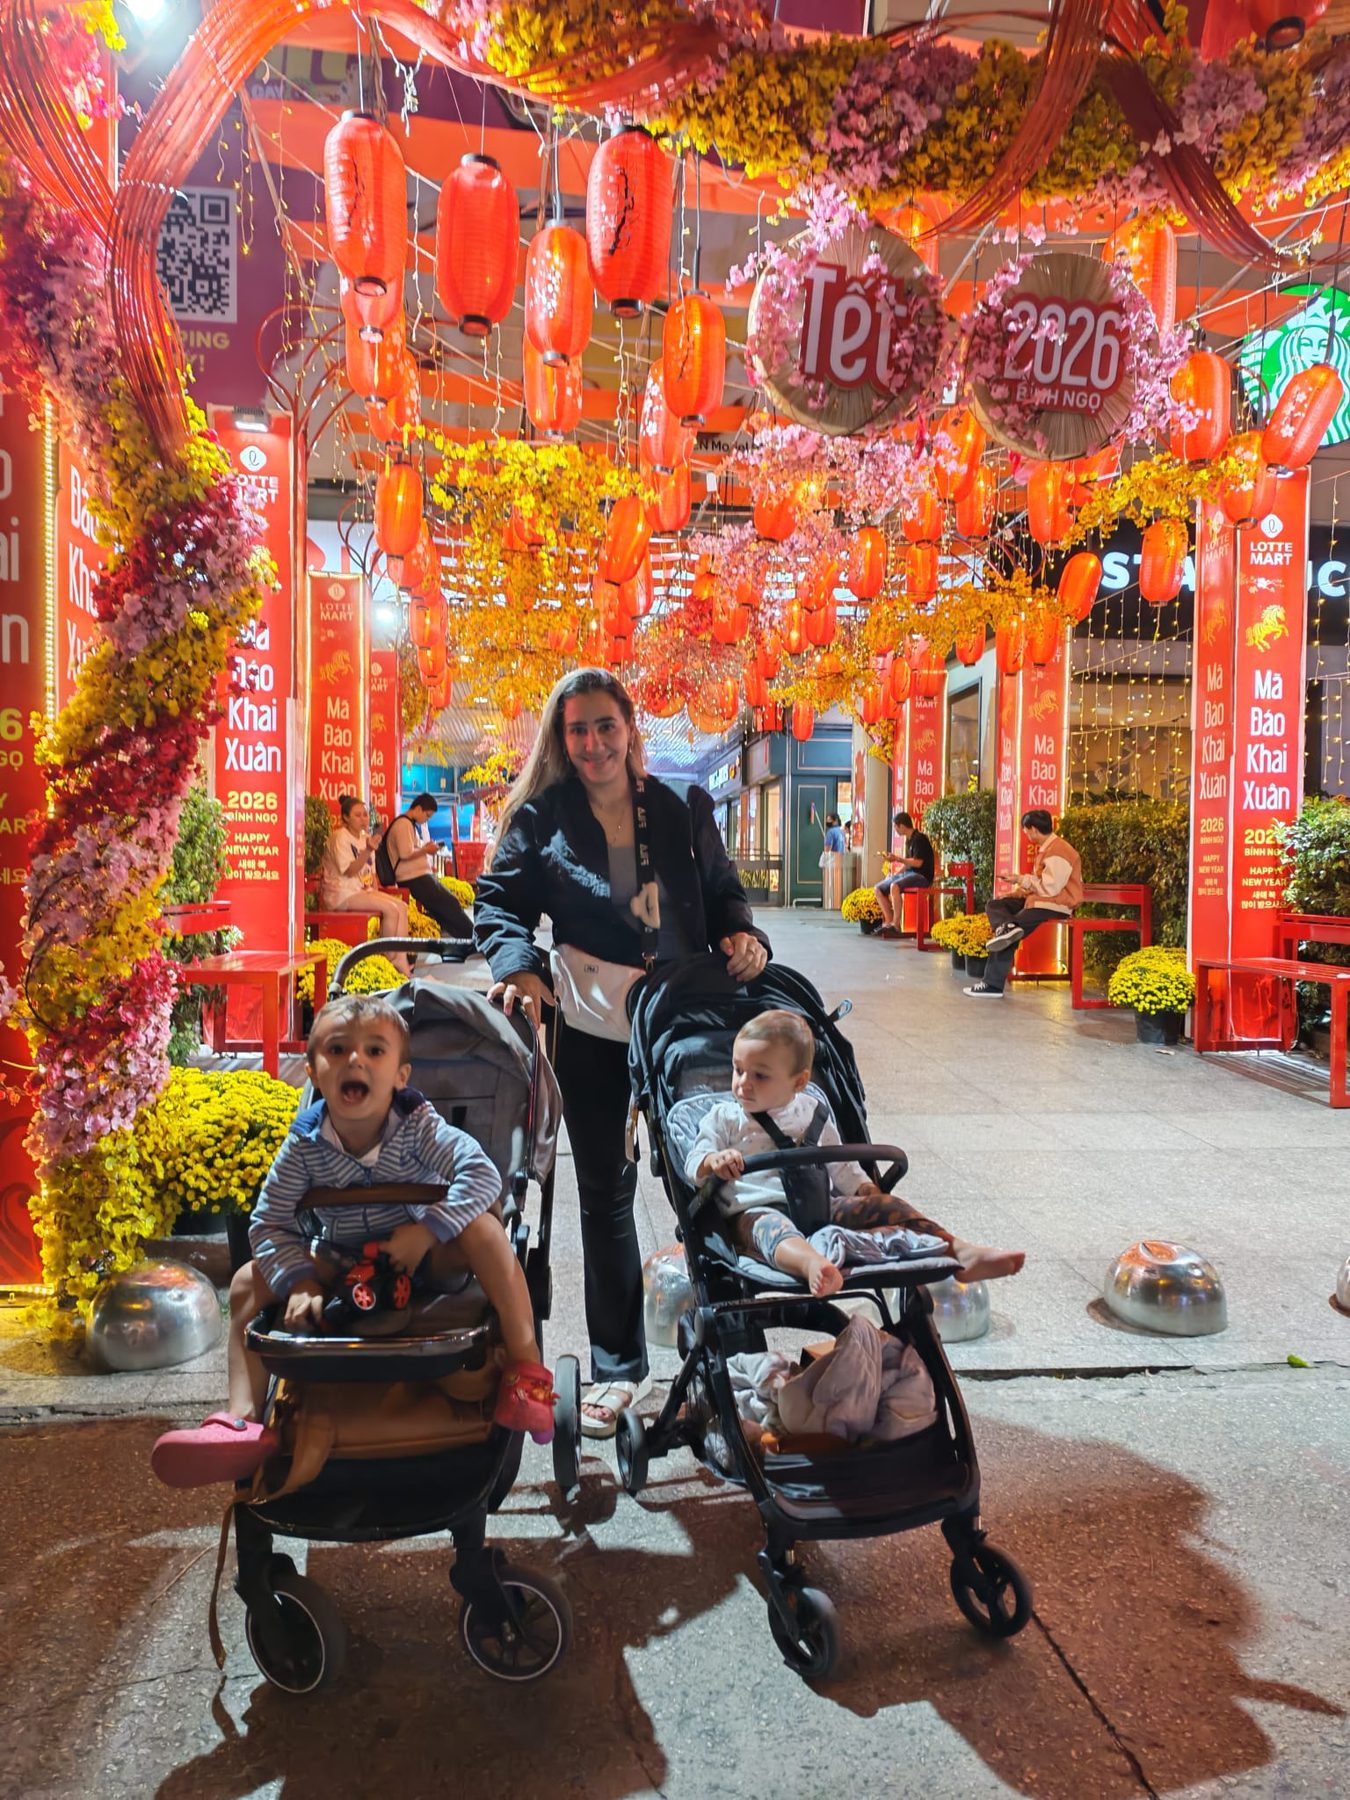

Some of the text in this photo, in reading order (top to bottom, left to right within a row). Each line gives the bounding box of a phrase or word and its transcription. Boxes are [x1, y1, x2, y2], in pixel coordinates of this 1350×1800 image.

[804, 266, 908, 388] Tết
[1003, 301, 1123, 390] 2026
[1063, 390, 1101, 414] NGỌ
[237, 474, 279, 488] OTTE
[1250, 541, 1293, 552] LOTTE
[1250, 553, 1293, 566] MART
[320, 611, 354, 621] MART
[228, 696, 277, 732] Khai
[1250, 706, 1286, 737] Đáo
[224, 737, 282, 773] Xuân
[1202, 732, 1226, 765] Khai
[1247, 743, 1289, 773] Khai
[0, 750, 24, 771] GỌ
[321, 750, 355, 774] Khai
[226, 789, 278, 811] 2026
[371, 790, 388, 808] hai
[1028, 784, 1059, 807] Khai
[1242, 780, 1291, 810] Xuân
[255, 812, 278, 826] NGỌ
[1200, 817, 1225, 834] 2026
[234, 832, 270, 844] HAPPY
[1244, 828, 1285, 846] 202
[225, 844, 280, 857] NEW YEAR
[1244, 846, 1266, 857] BÍNH
[1242, 878, 1262, 887] NEW
